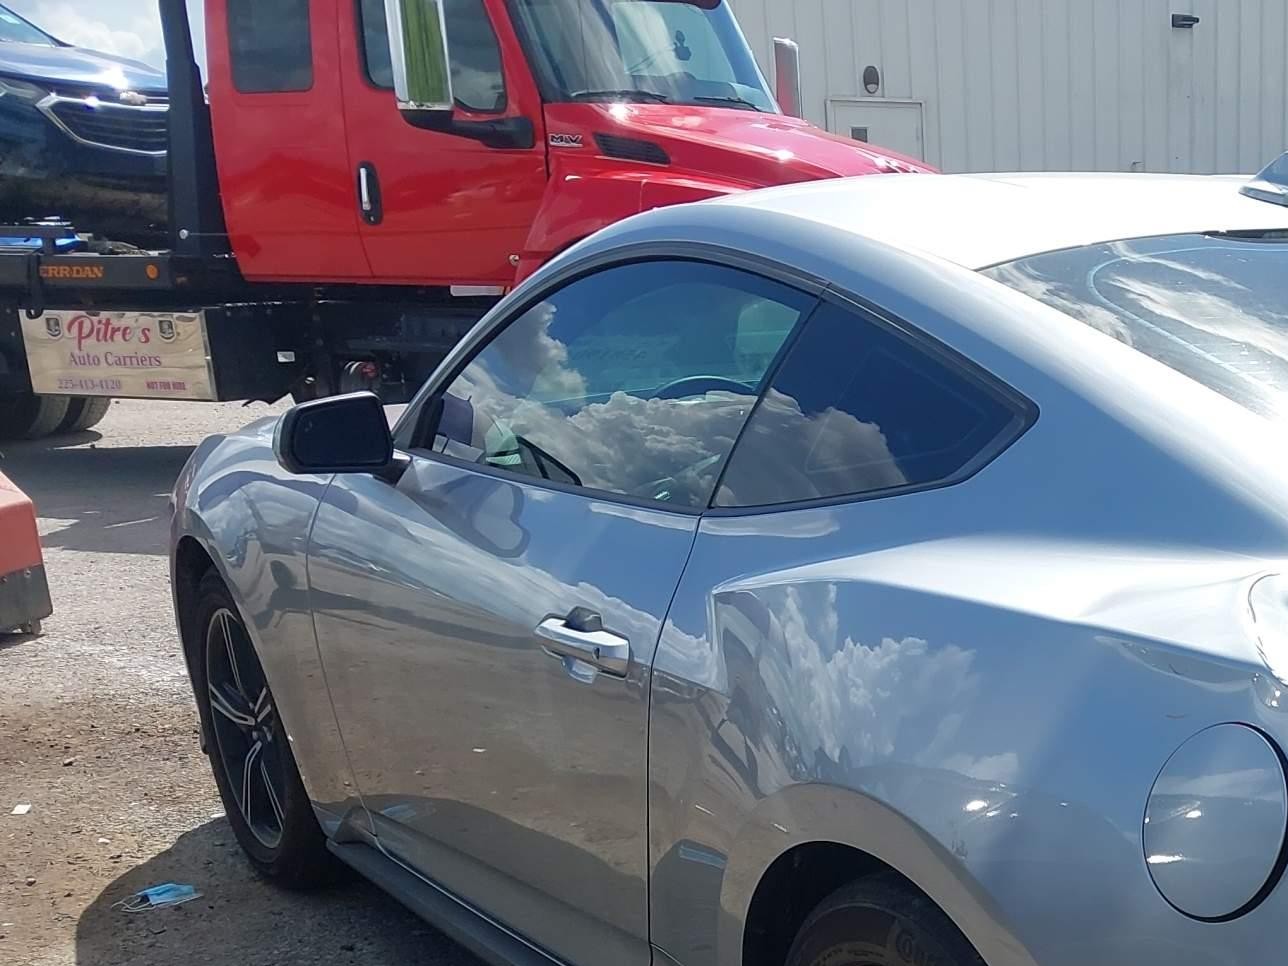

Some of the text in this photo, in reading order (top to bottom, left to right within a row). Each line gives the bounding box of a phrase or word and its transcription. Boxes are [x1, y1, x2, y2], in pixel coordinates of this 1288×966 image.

[549, 133, 583, 146] MV
[67, 315, 151, 351] Pitre's
[69, 351, 162, 368] Auto Carriers
